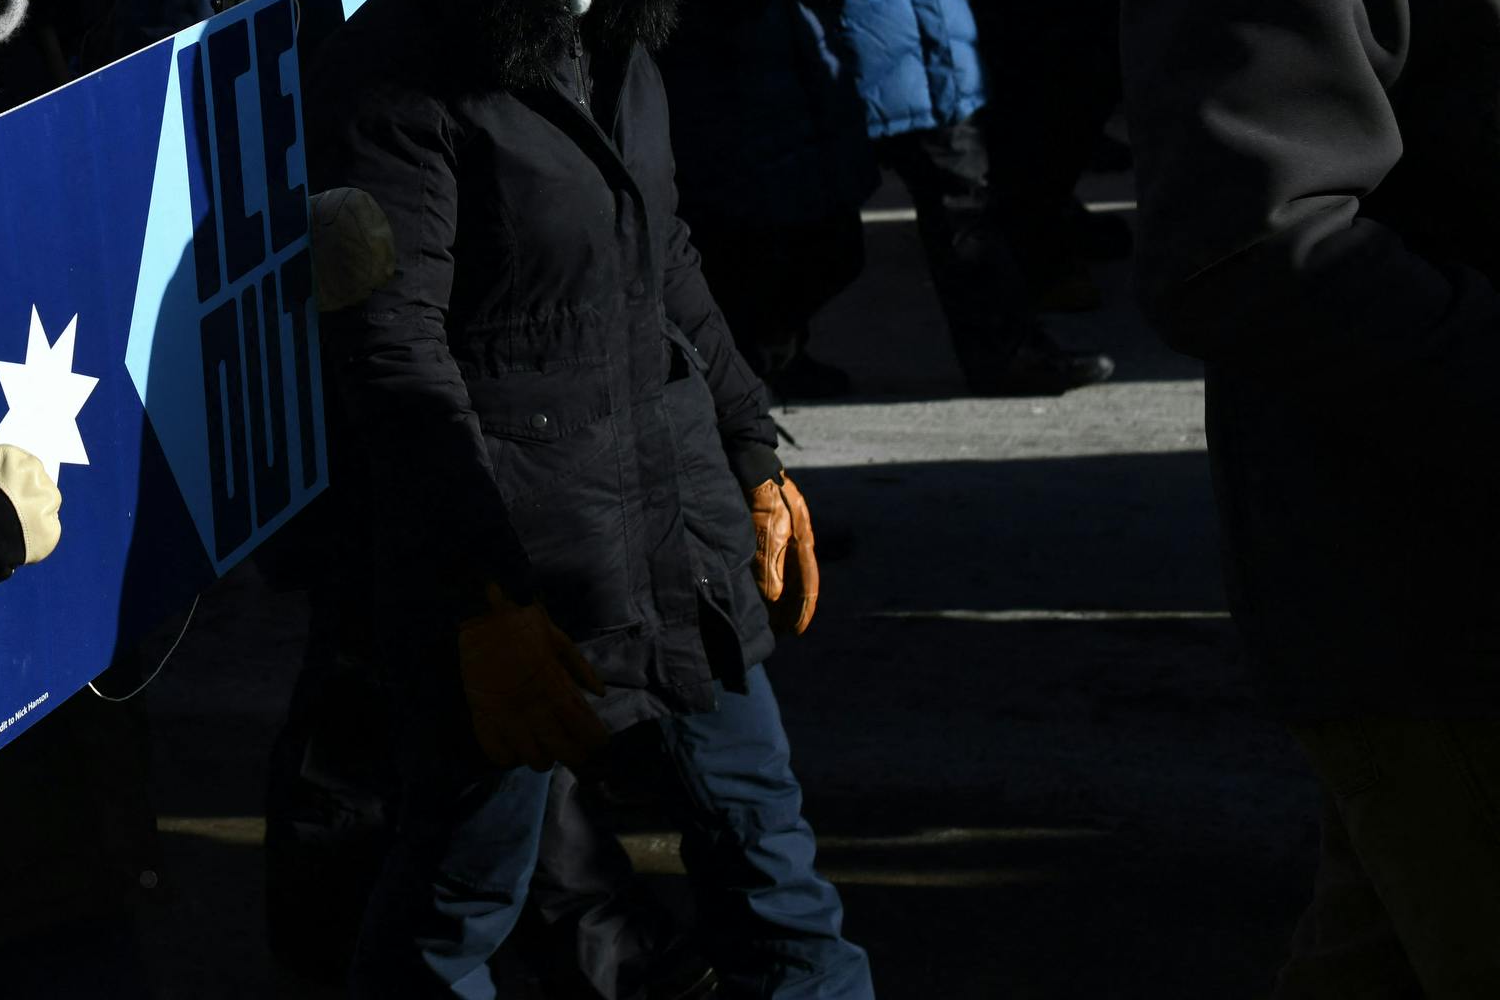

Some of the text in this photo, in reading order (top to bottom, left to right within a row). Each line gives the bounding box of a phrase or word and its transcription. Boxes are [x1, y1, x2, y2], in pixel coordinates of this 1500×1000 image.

[200, 245, 317, 563] OUT
[8, 716, 15, 726] to
[14, 705, 28, 721] Nick
[27, 691, 49, 712] Hanson
